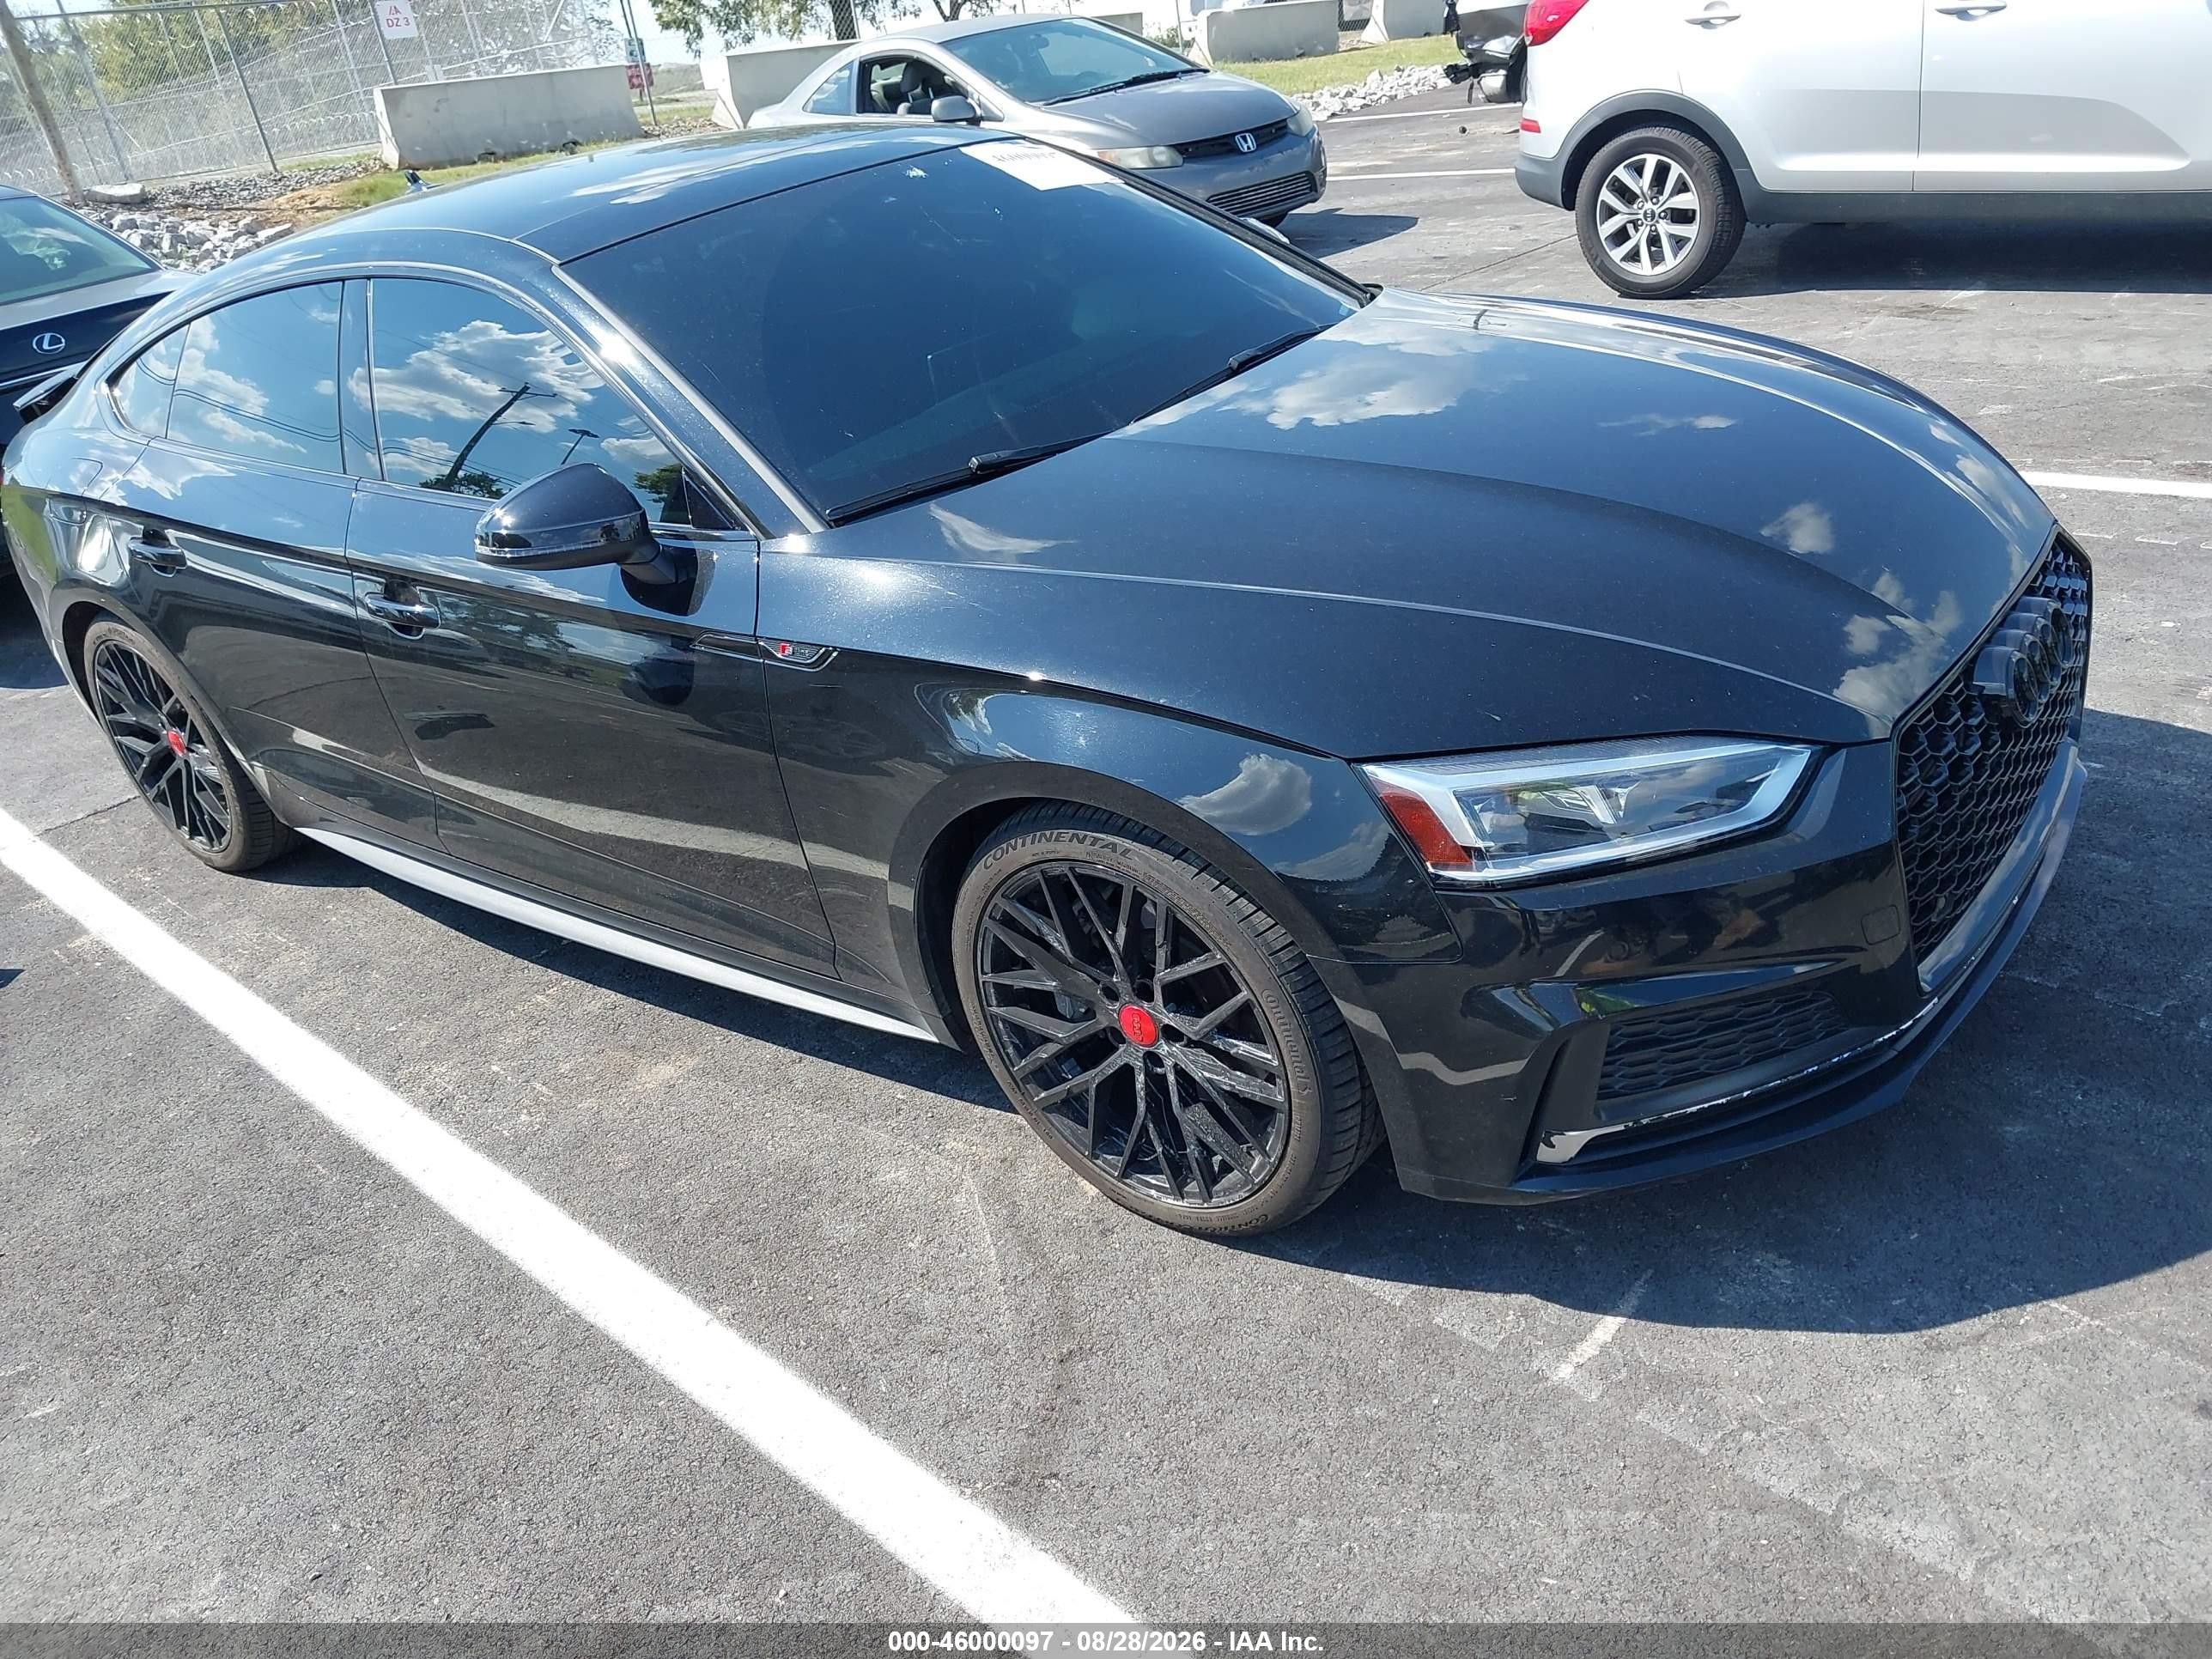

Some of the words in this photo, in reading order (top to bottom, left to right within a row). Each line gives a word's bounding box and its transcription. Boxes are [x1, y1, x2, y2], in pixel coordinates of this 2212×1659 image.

[386, 17, 402, 27] DZ
[404, 17, 410, 27] 3
[983, 830, 1139, 871] CONTINENTAL
[1261, 988, 1310, 1084] Continental
